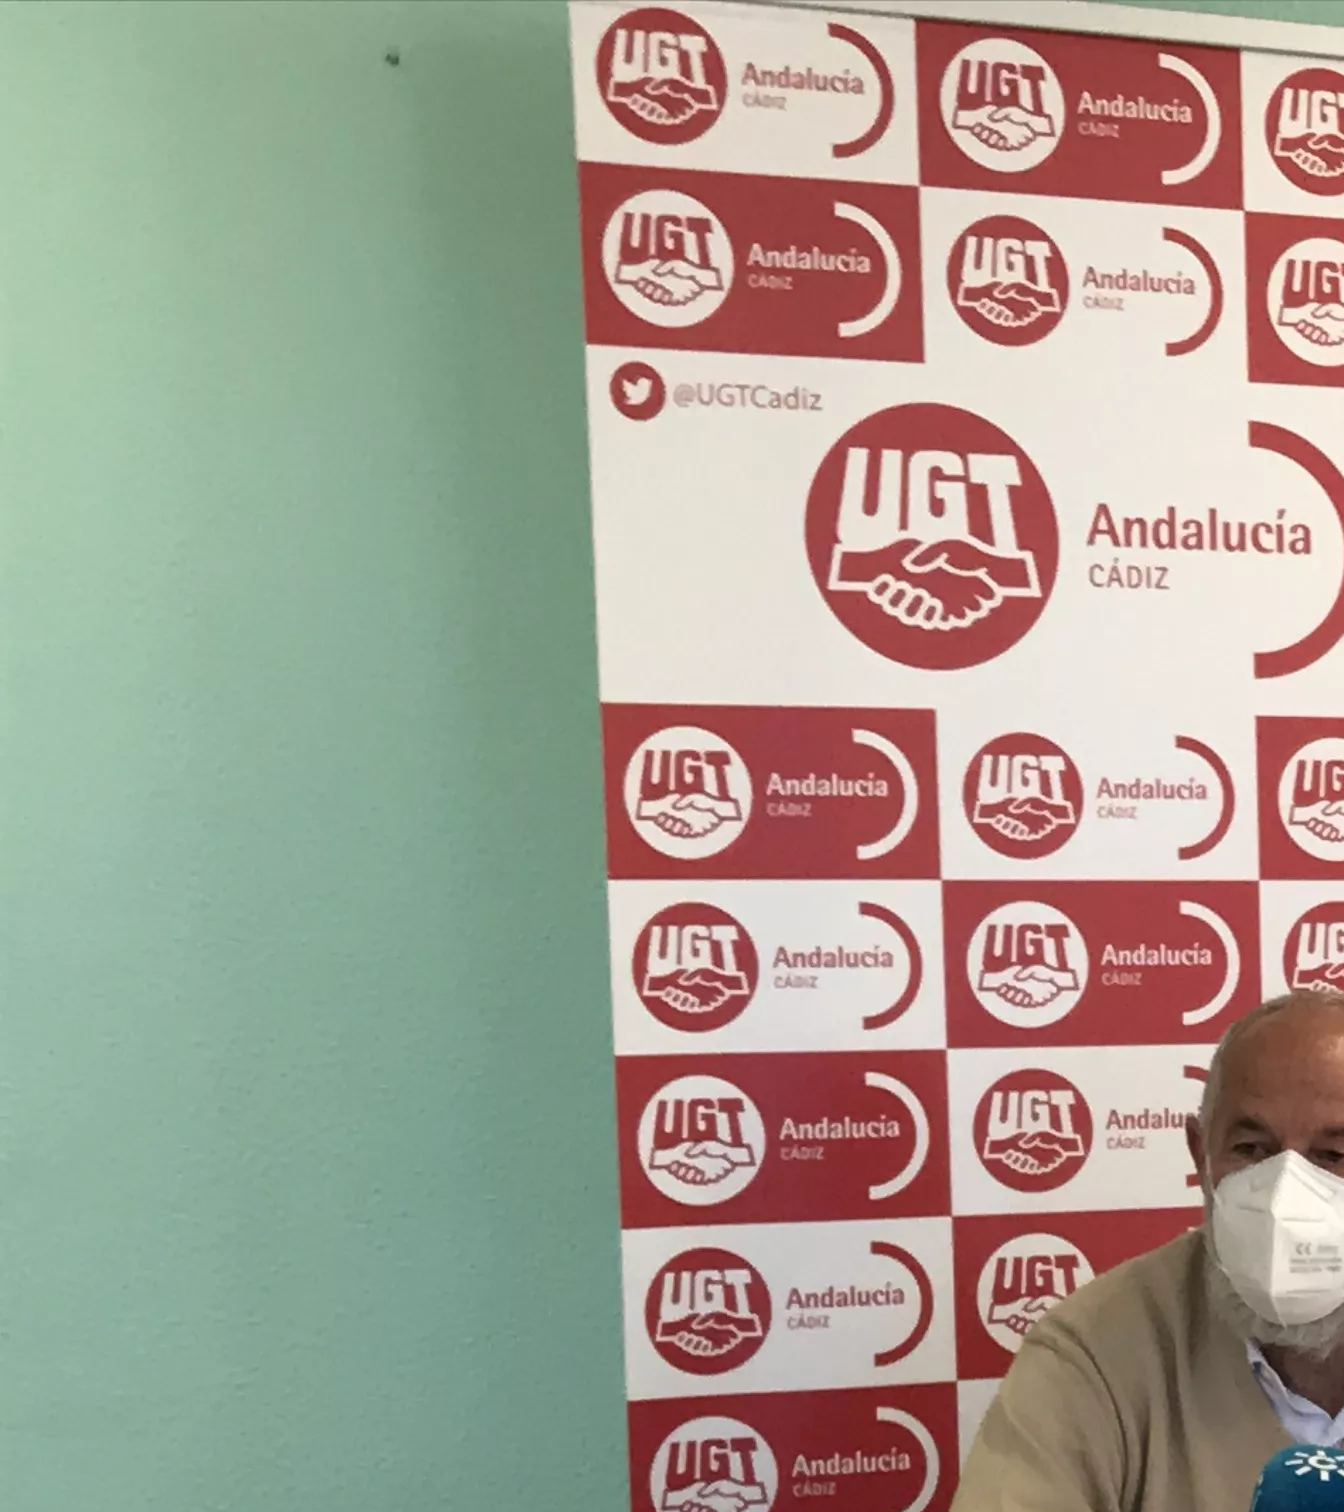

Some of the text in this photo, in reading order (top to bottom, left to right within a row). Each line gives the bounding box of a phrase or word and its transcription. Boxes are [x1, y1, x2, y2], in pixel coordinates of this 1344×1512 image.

[612, 31, 707, 82] UGT
[959, 59, 1047, 115] UGT
[622, 212, 713, 272] UGT
[966, 237, 1055, 296] UGT
[673, 383, 822, 411] @UGTCadiz
[837, 448, 1021, 557] UGT
[1087, 503, 1311, 554] Andalucía
[1089, 558, 1169, 589] CÁDIZ
[646, 751, 734, 804] UGT
[767, 773, 888, 796] Andalucía
[978, 754, 1065, 803] UGT
[1097, 778, 1207, 800] Andalucía
[651, 923, 739, 976] UGT
[773, 946, 893, 968] Andalucía
[982, 923, 1071, 973] UGT
[1101, 943, 1212, 965] Andalucía
[656, 1098, 746, 1153] UGT
[780, 1115, 900, 1140] Andalucía
[989, 1090, 1075, 1141] UGT
[664, 1270, 752, 1320] UGT
[786, 1283, 904, 1309] Andalucía
[992, 1255, 1078, 1301] UGT
[668, 1439, 757, 1492] UGT
[792, 1448, 910, 1477] Andalucía
